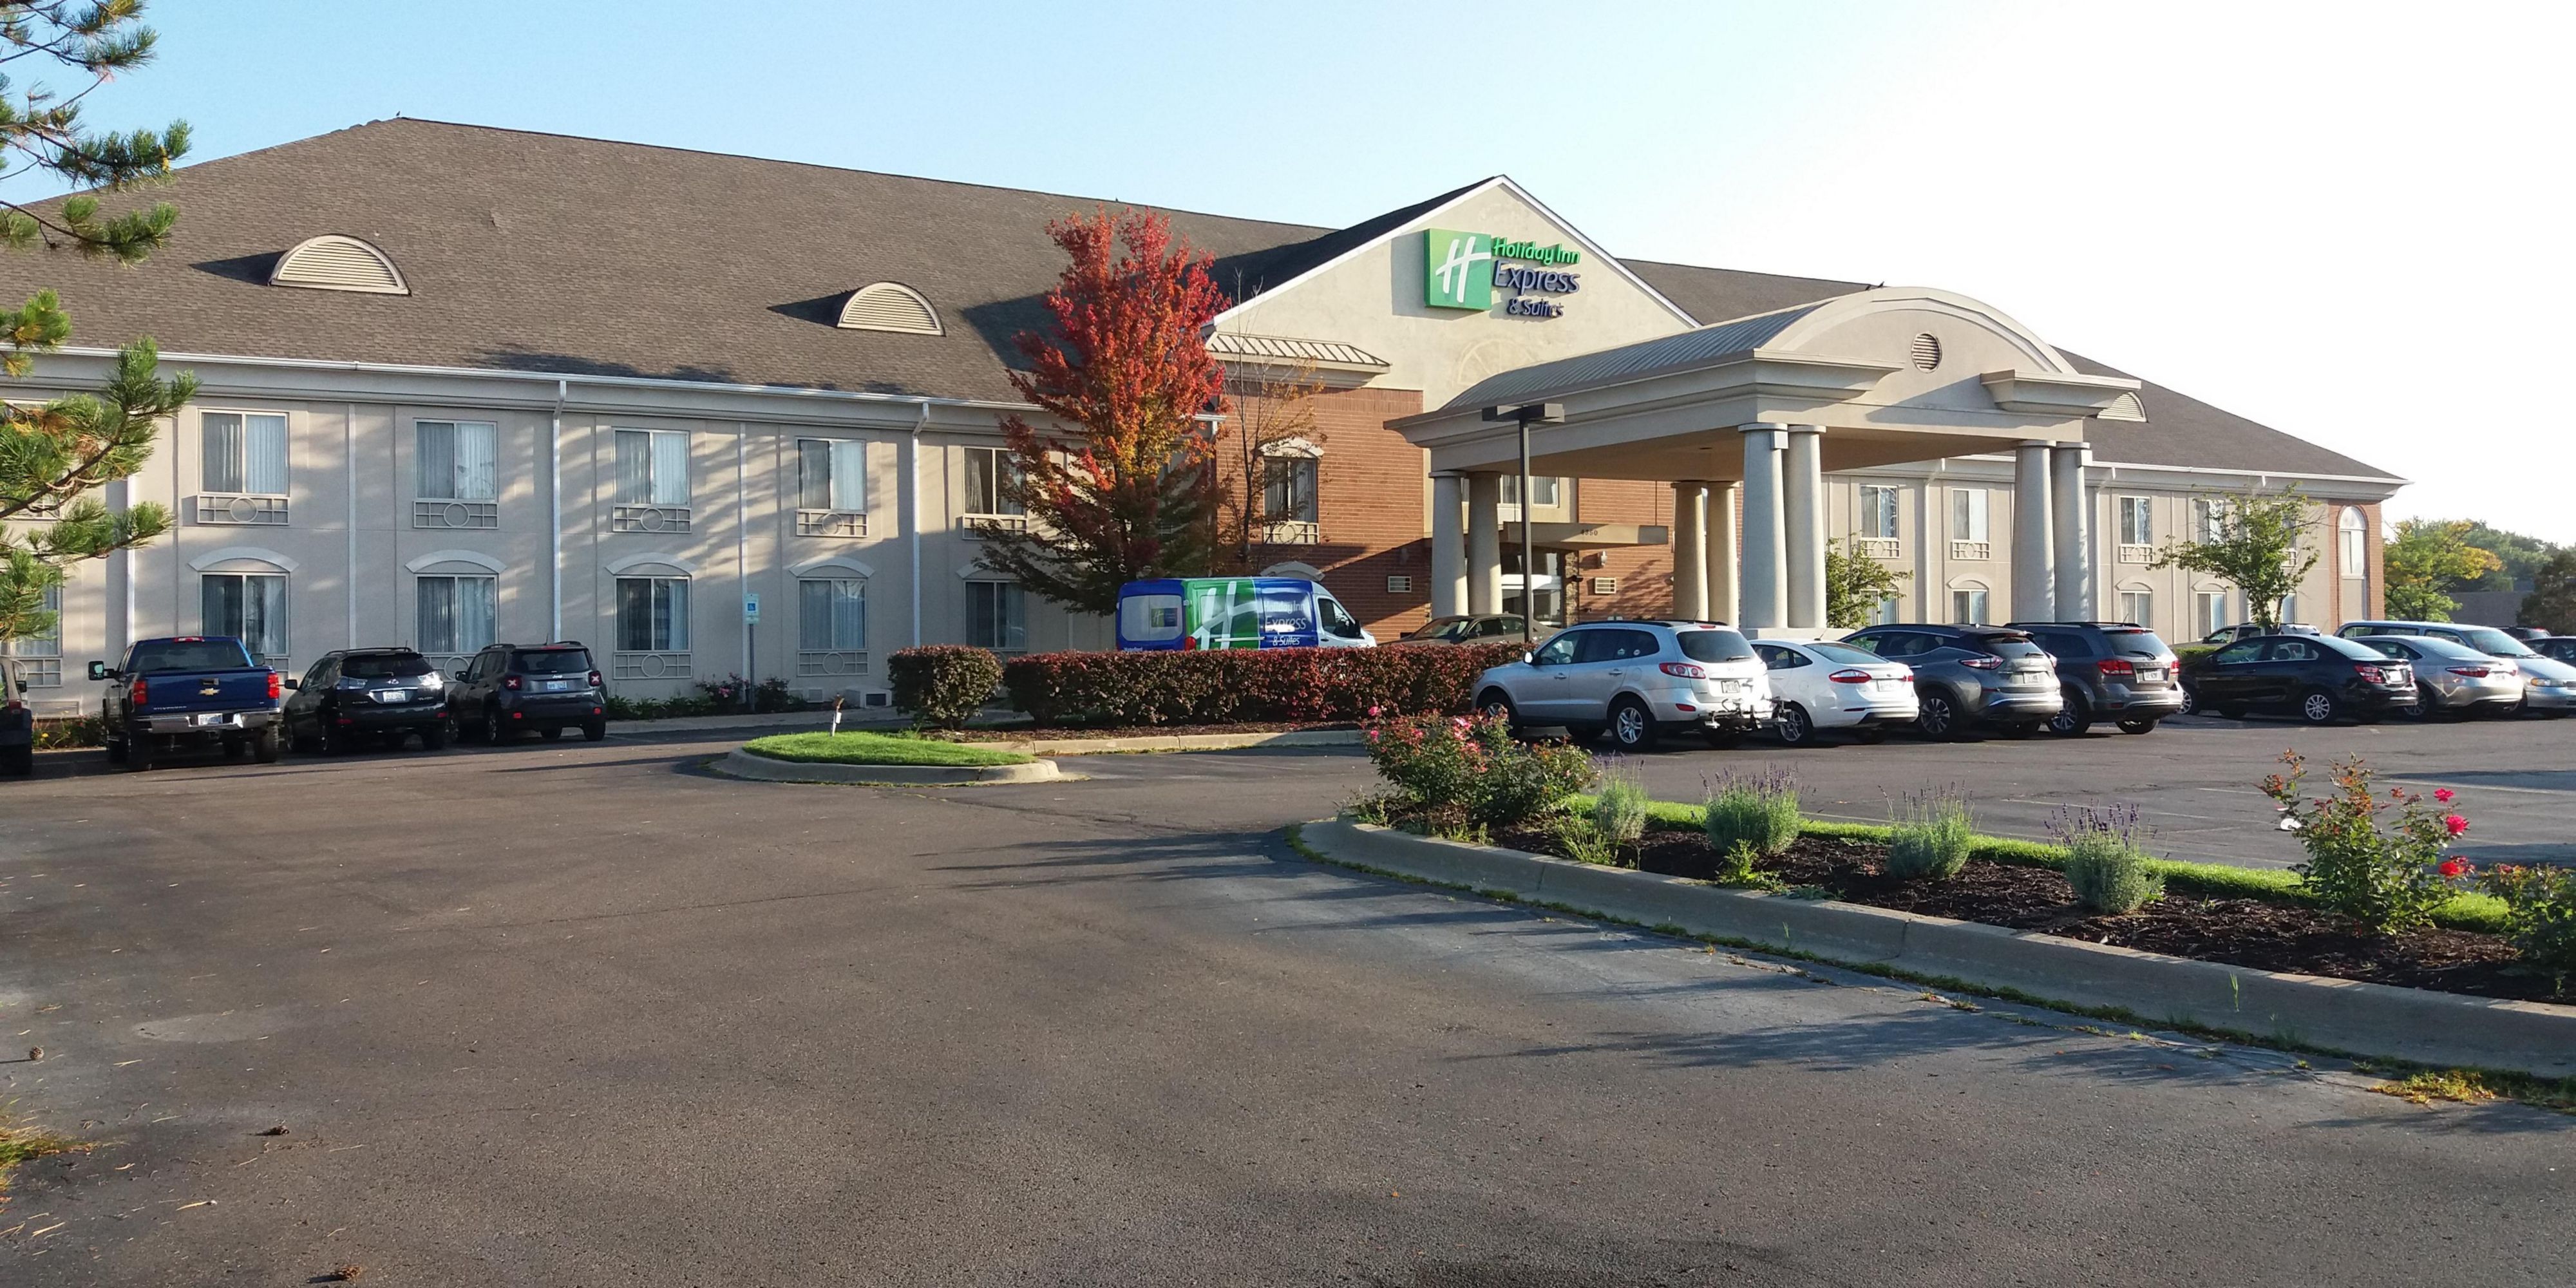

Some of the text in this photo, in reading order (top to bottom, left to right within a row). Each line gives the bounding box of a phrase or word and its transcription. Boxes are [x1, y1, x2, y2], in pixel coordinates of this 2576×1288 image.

[1493, 237, 1581, 265] Holiday Inn
[1493, 260, 1581, 296] Express
[1508, 298, 1564, 317] & Suites
[1265, 600, 1306, 614] Holiday Inn
[1272, 636, 1300, 646] & Suites
